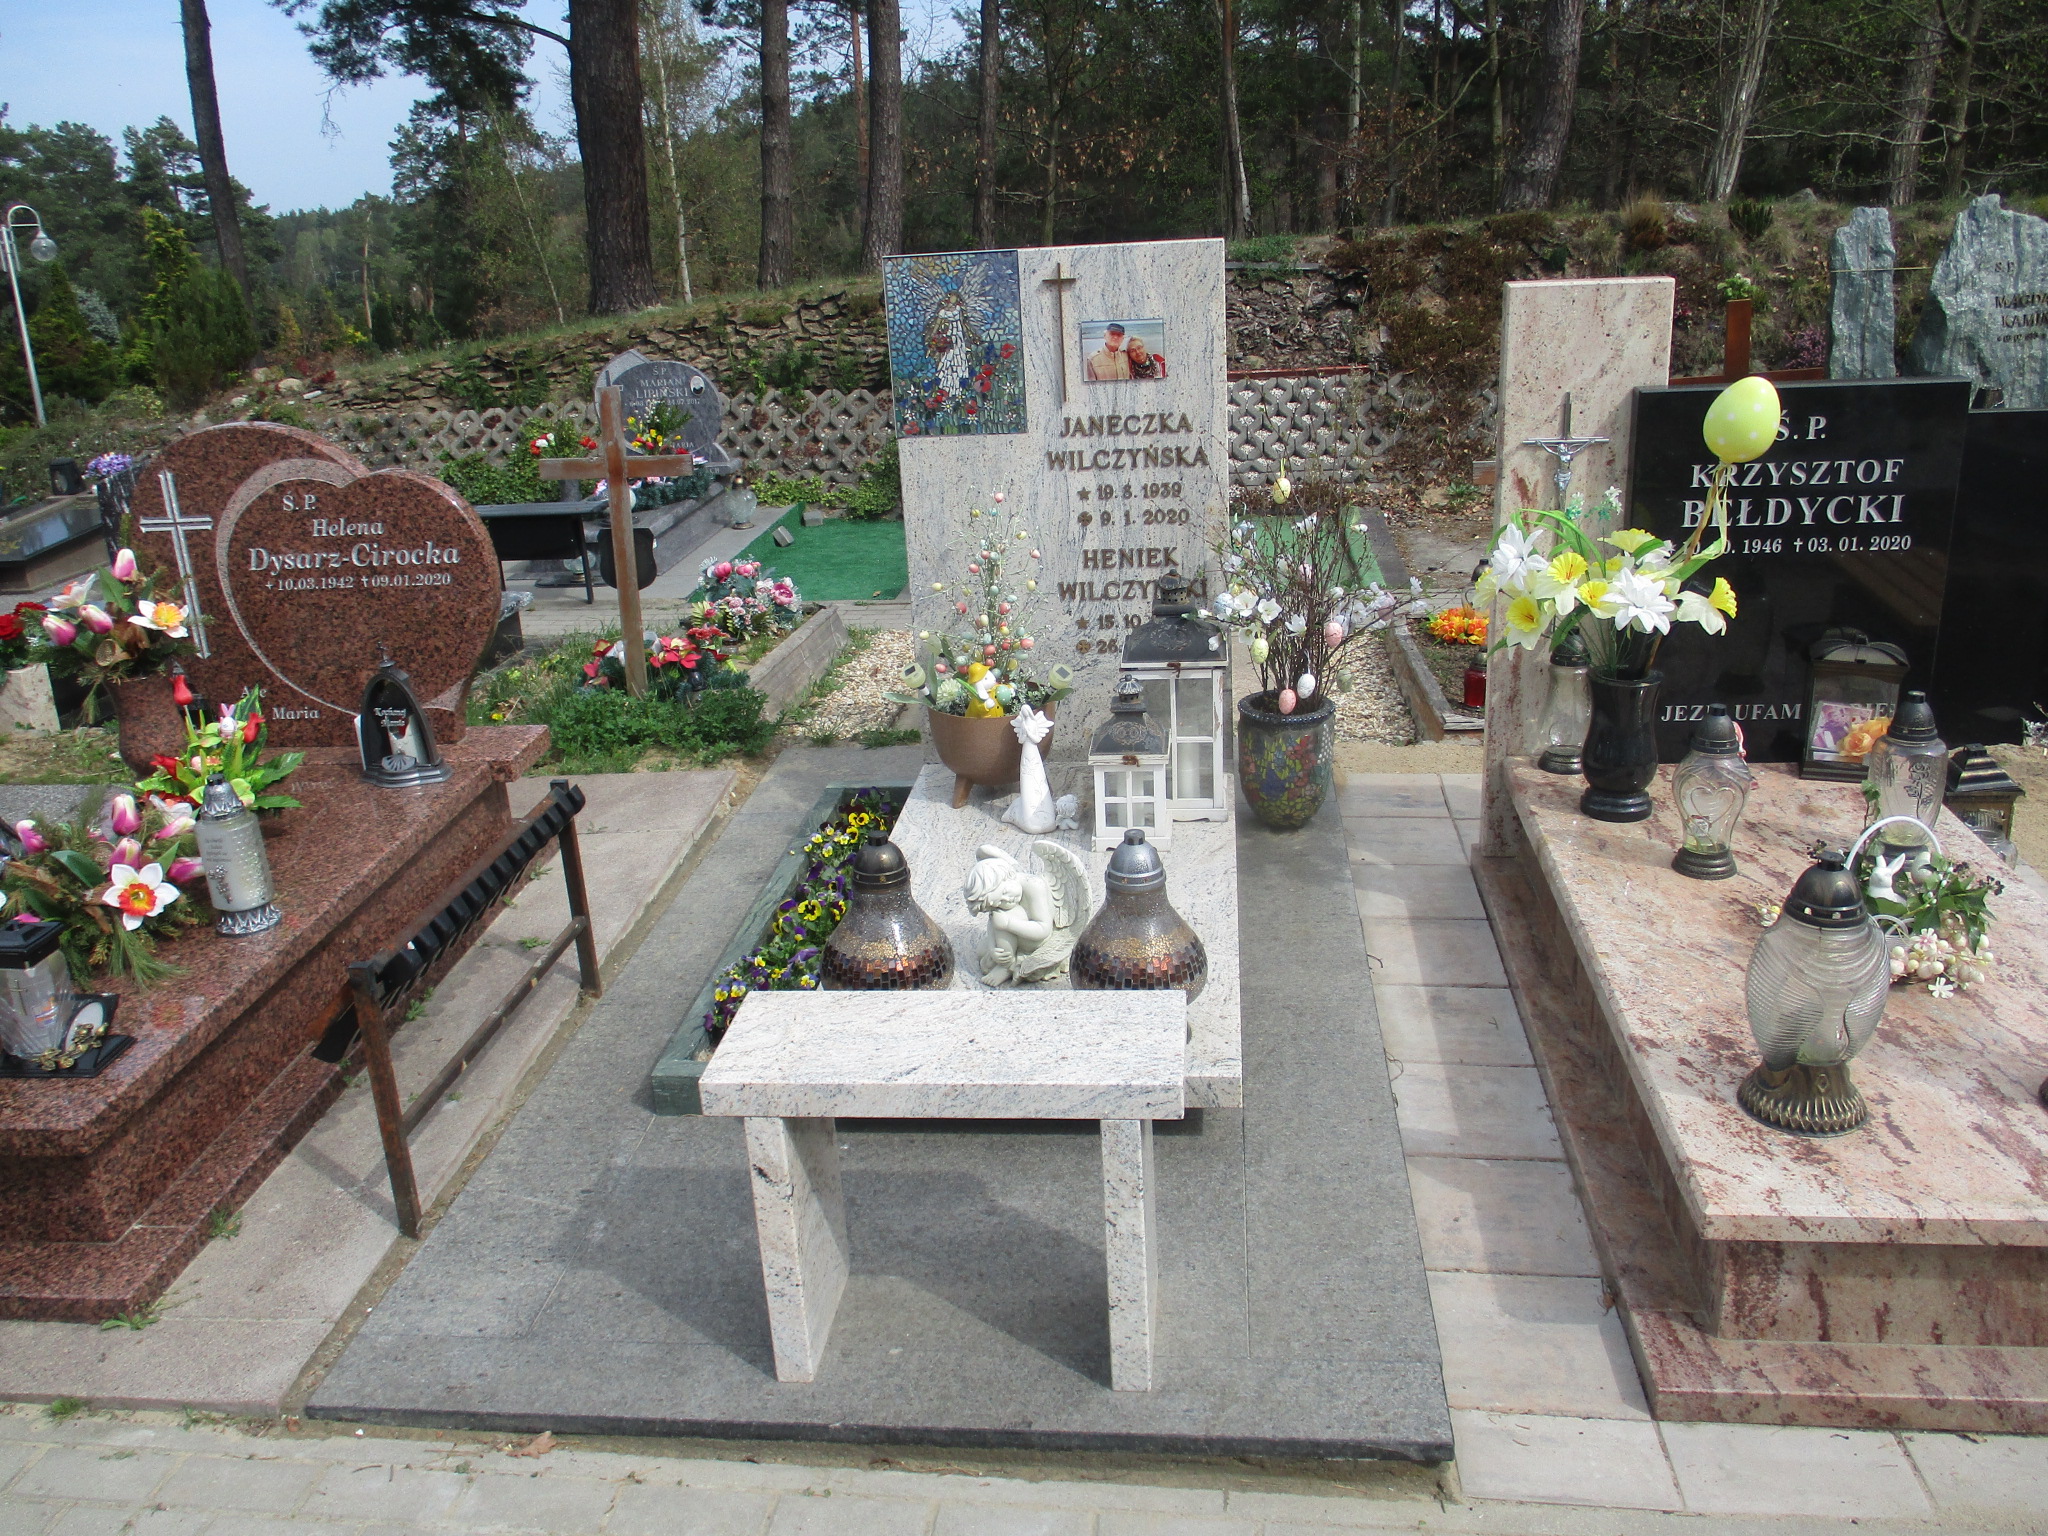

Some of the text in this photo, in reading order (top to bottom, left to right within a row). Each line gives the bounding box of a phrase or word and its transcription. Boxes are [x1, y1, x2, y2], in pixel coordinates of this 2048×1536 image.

[1060, 412, 1193, 437] JANECZKA
[1805, 416, 1828, 441] P.
[1047, 444, 1209, 472] WILCZYŃSKA
[1690, 459, 1904, 488] KRZYSZTOF
[282, 492, 316, 511] Ś. P.
[1142, 508, 1190, 525] 2020
[312, 518, 385, 537] Helena
[1742, 539, 1783, 554] 1946
[1808, 535, 1912, 553] 03. 01. 2020
[248, 541, 460, 576] Dysarz-Cirocka
[1083, 547, 1180, 569] HENIEK
[277, 577, 354, 591] 10.03.1942
[371, 573, 451, 588] 09.01.2020
[1057, 577, 1208, 602] WILCZYKI
[272, 706, 319, 720] Maria
[1660, 703, 1802, 722] JEZ UFAM
